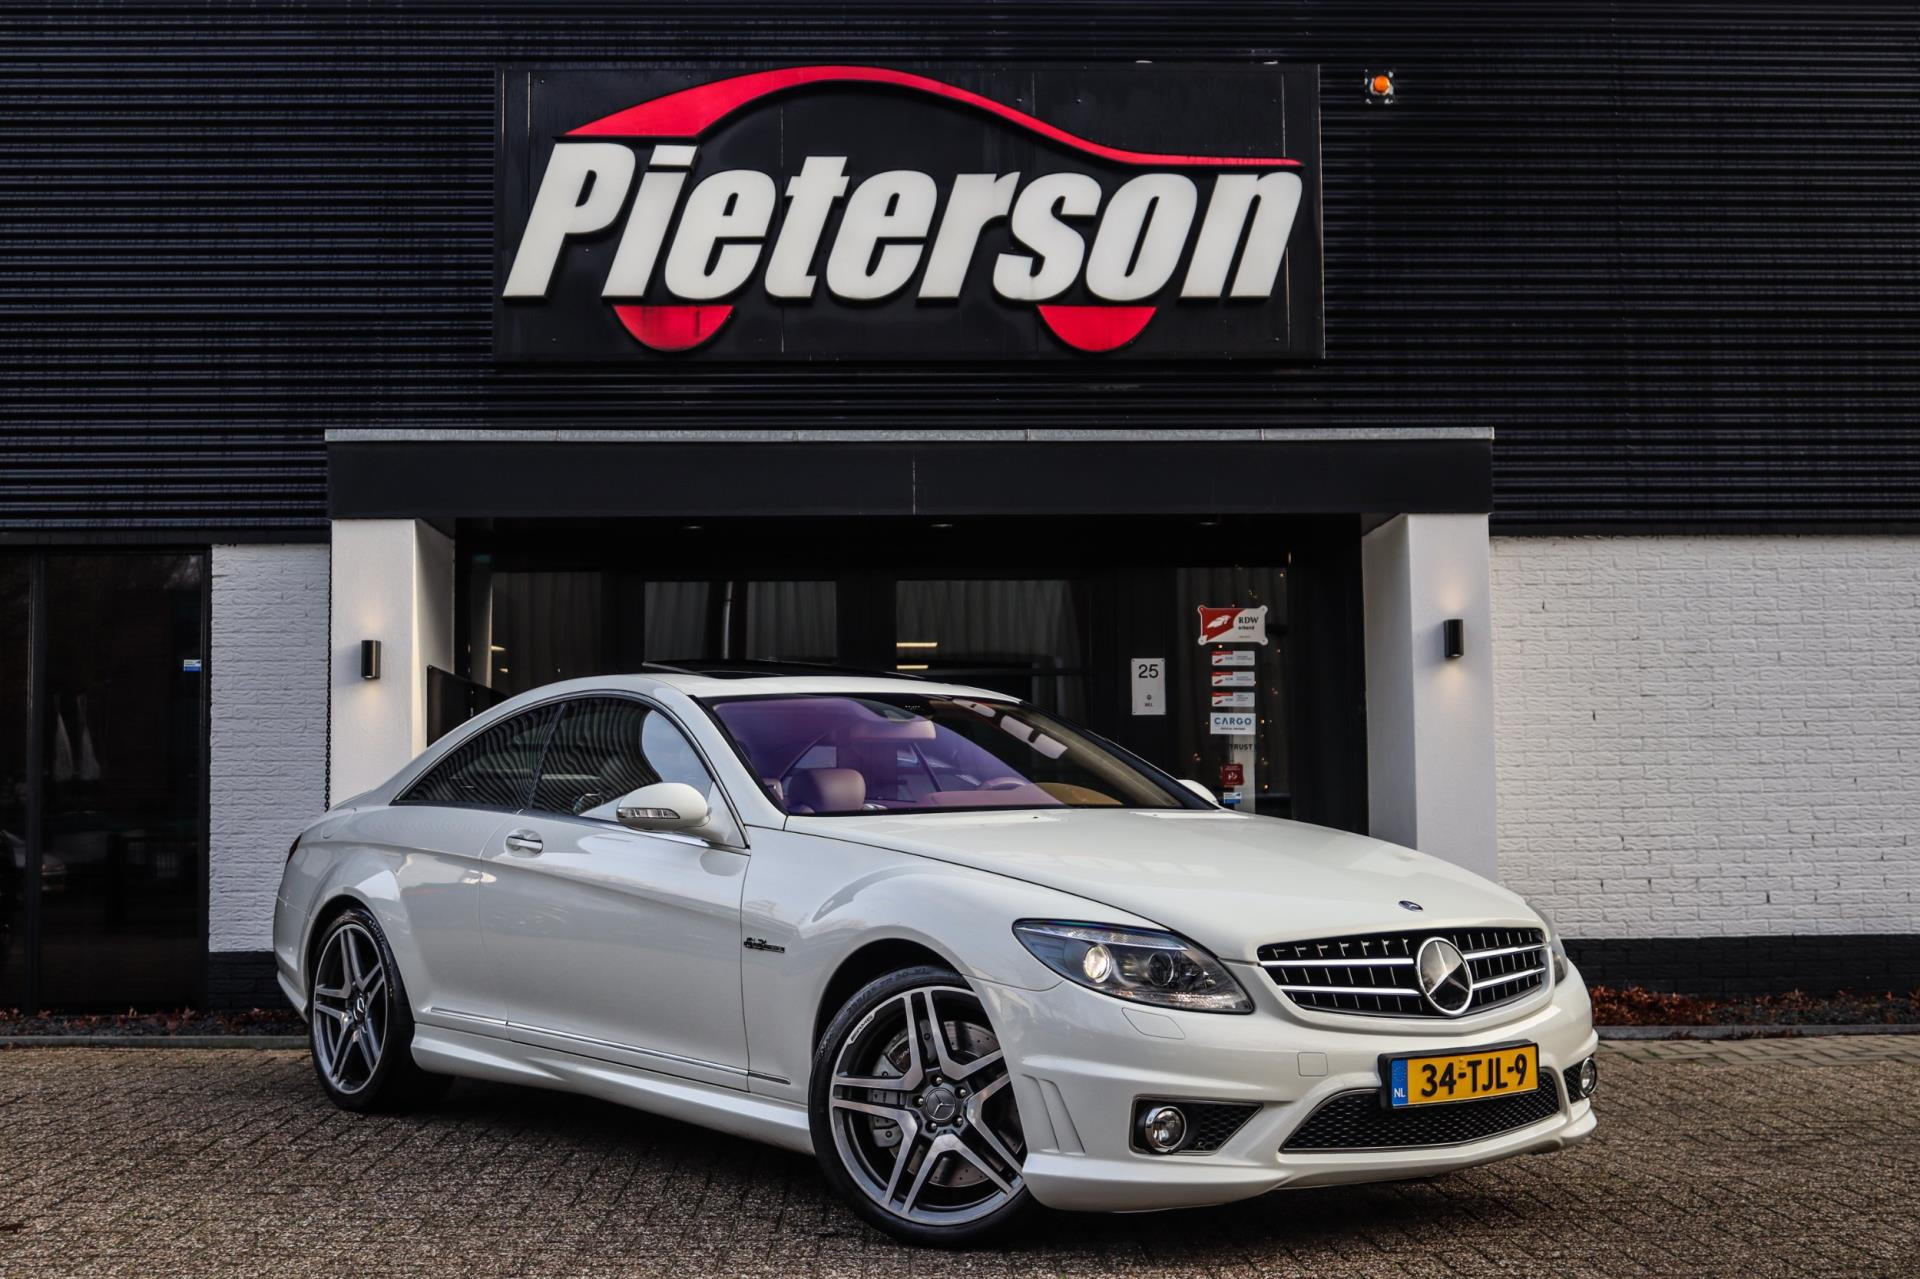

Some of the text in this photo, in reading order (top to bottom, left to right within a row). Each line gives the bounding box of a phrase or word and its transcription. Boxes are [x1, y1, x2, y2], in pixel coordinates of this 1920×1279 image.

[502, 141, 1304, 303] Pieterson
[1238, 616, 1259, 624] RDW
[1138, 664, 1159, 679] 25
[1214, 717, 1252, 725] CARGO
[1421, 1053, 1528, 1097] 34-TJL-9
[1393, 1087, 1406, 1098] NL
